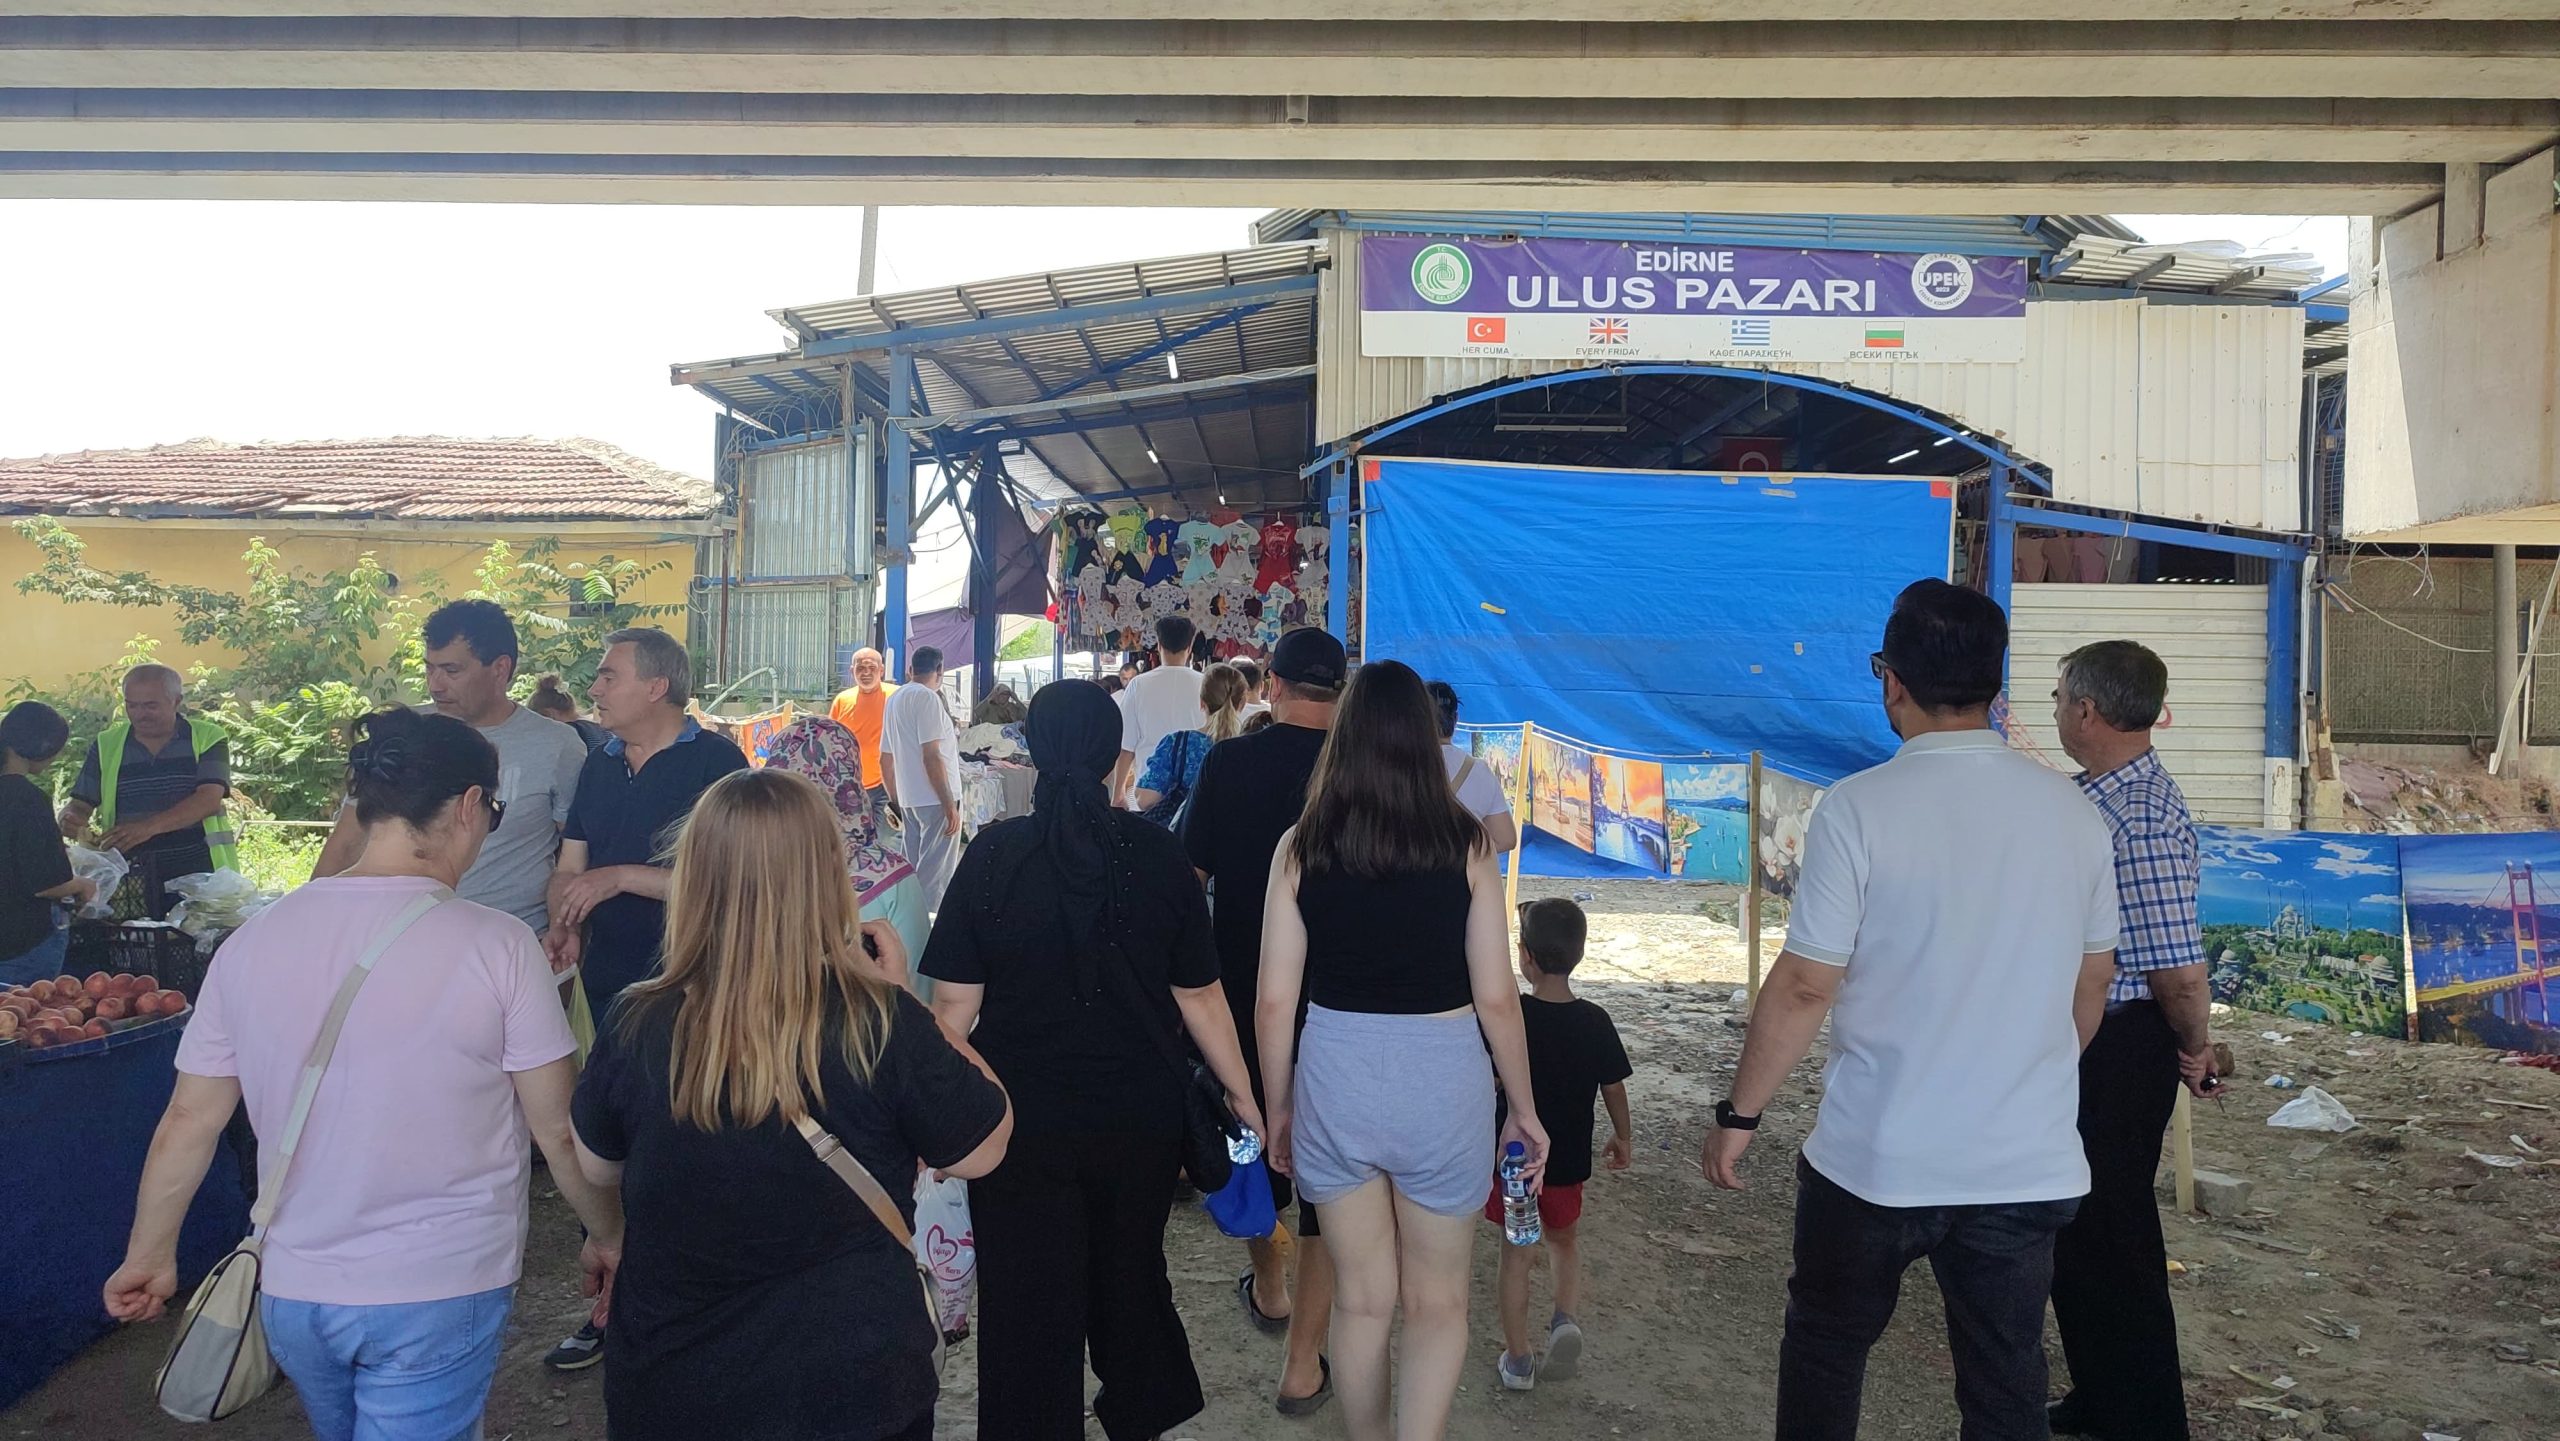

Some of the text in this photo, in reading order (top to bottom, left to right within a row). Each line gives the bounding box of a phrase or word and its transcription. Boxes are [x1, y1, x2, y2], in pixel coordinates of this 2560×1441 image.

[1636, 247, 1734, 273] EDİRNE
[1919, 271, 1967, 287] UPEK
[1507, 276, 1876, 312] ULUS PAZARI
[1462, 346, 1509, 355] HER CUMA
[1575, 348, 1640, 356] EVERY FRIDAY
[1850, 350, 1919, 360] ВСЕКИ ПЕТЪК
